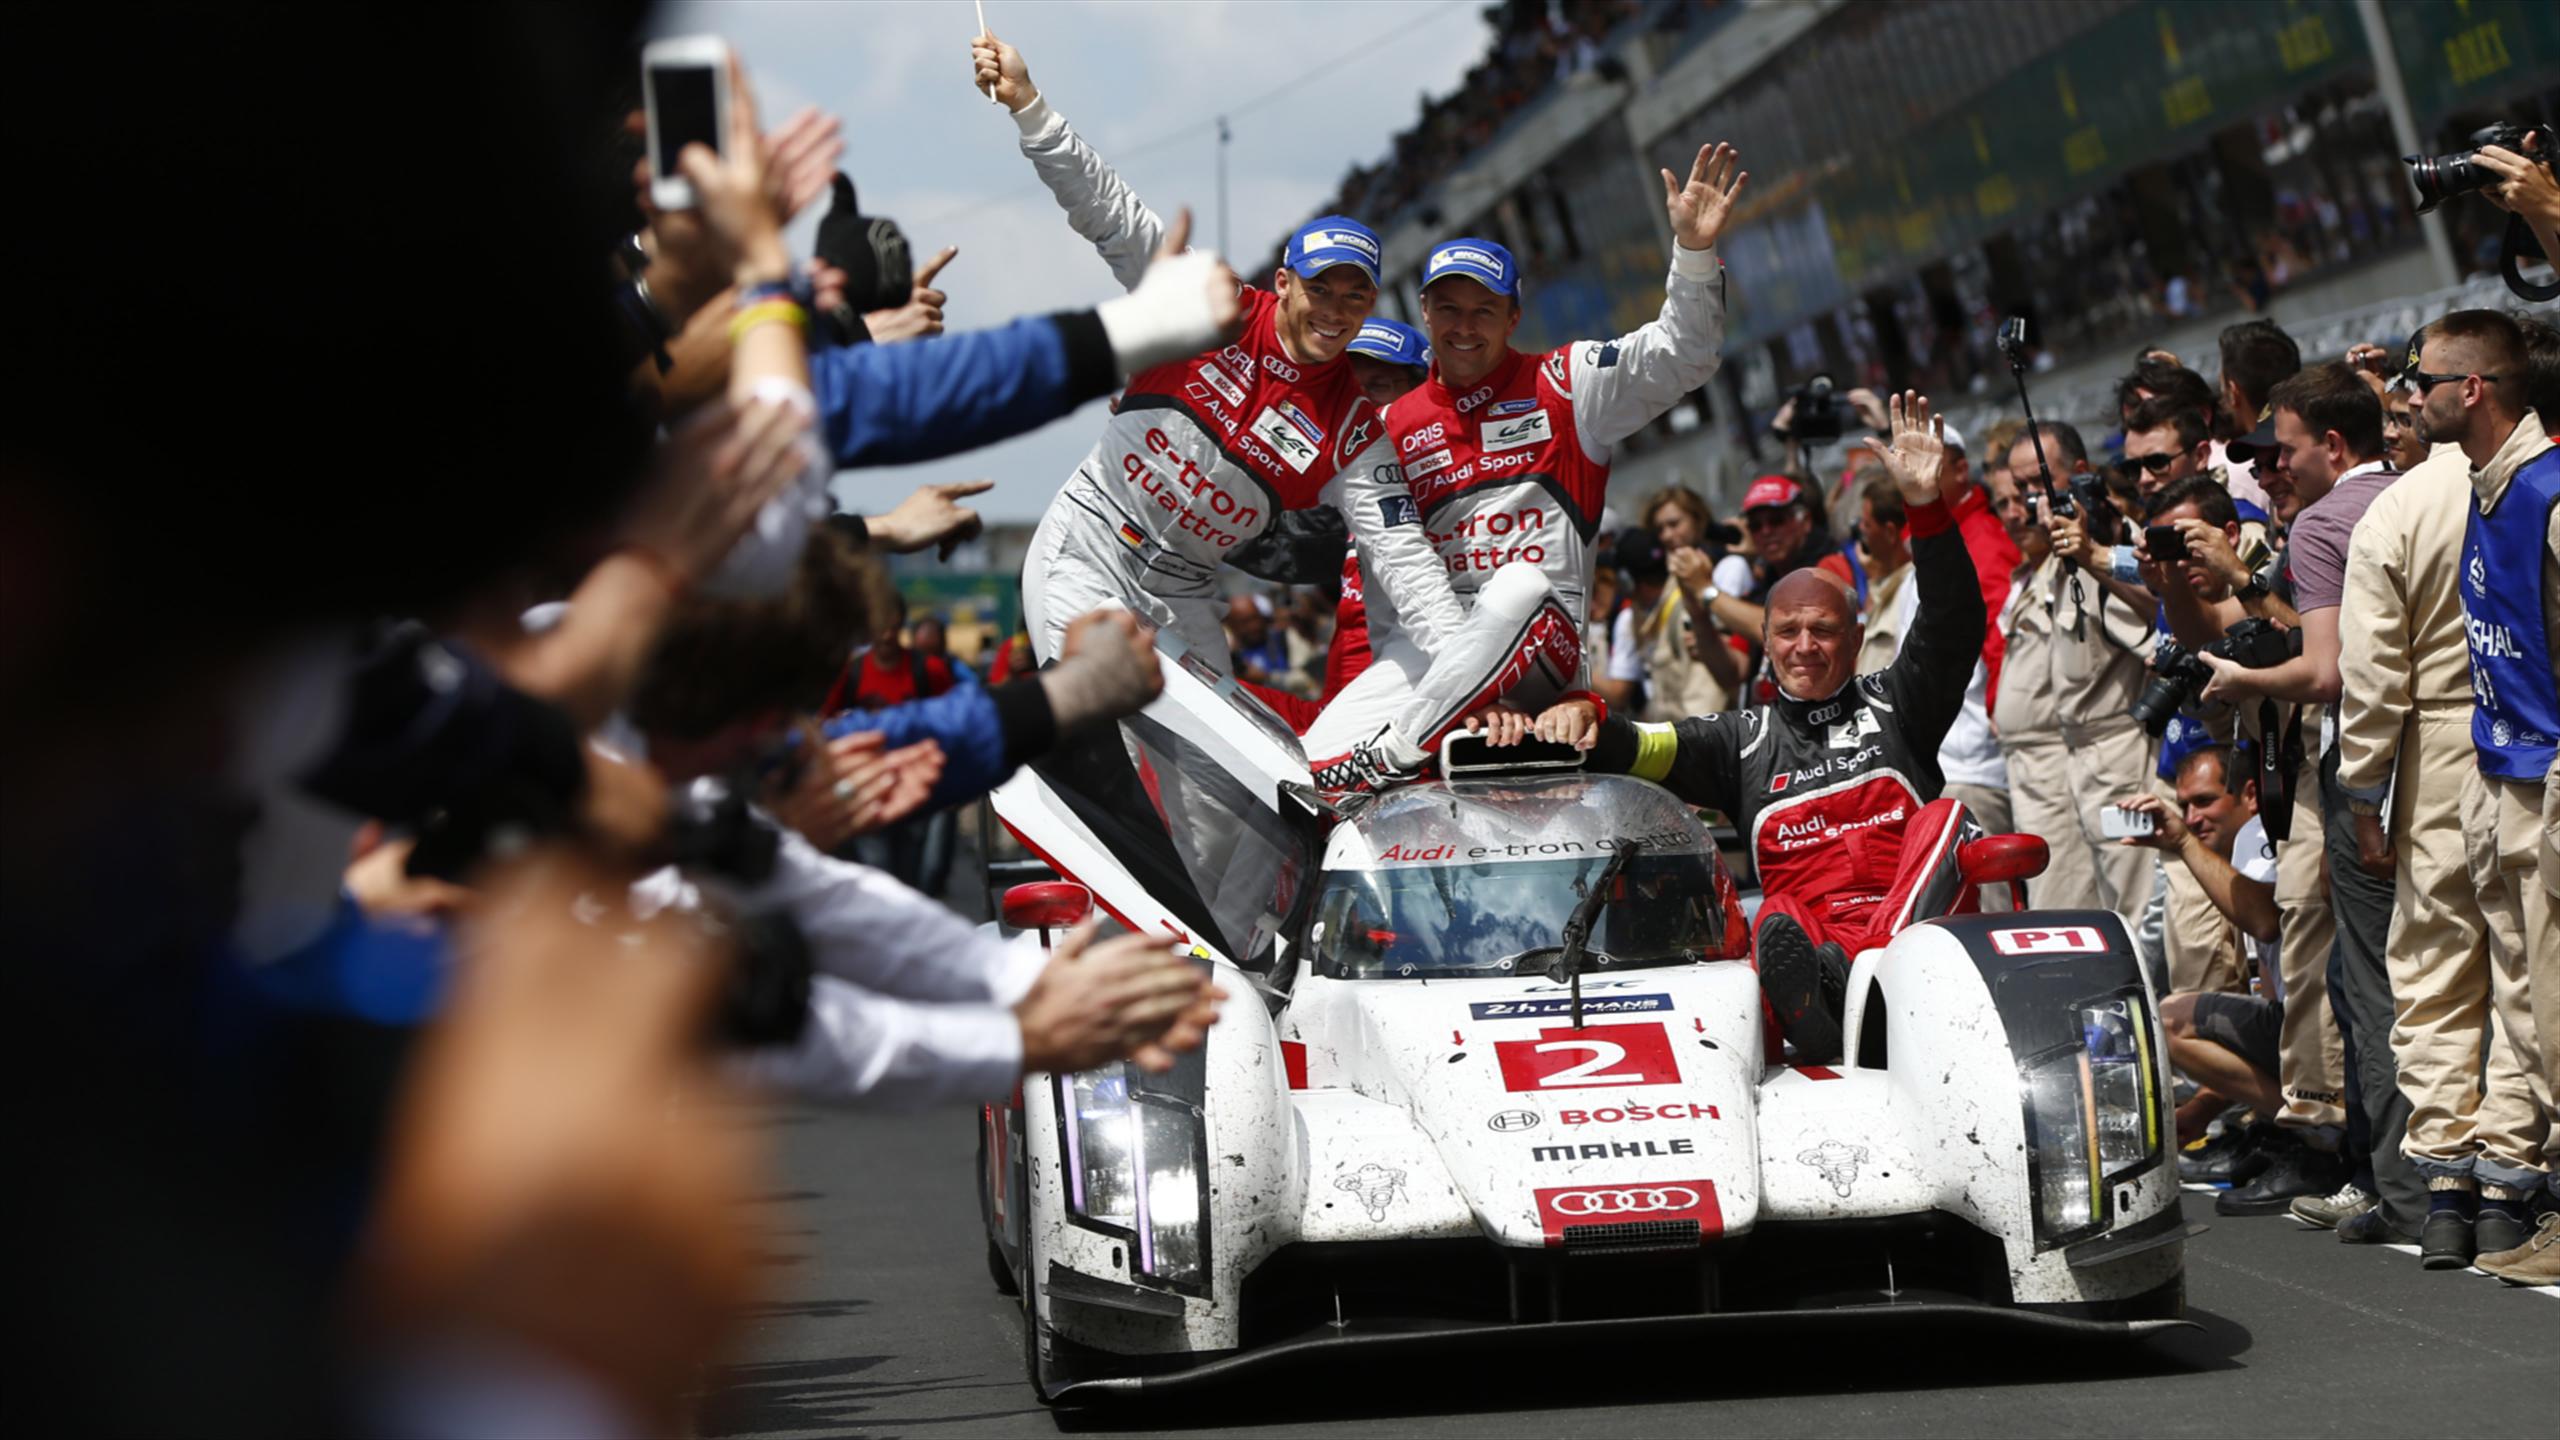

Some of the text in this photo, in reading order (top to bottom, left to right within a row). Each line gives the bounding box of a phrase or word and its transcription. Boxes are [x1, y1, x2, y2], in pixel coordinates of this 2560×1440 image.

[1333, 233, 1377, 254] MICHELIN
[1454, 251, 1501, 272] MICHELIN
[1357, 328, 1401, 343] ICHELIN
[1213, 377, 1242, 404] BOSCH
[1402, 422, 1444, 452] ORIS
[1499, 416, 1545, 437] WEC
[1238, 435, 1284, 477] Sport
[1420, 452, 1450, 470] BOSCH
[1145, 427, 1259, 528] e-tron
[1433, 450, 1536, 489] Audi Sport
[1123, 453, 1237, 548] quattro
[2264, 731, 2275, 771] Canon
[1794, 744, 1883, 785] Audi Sport
[1777, 814, 1827, 840] Audi
[1379, 843, 1458, 862] Audi
[1467, 840, 1585, 858] e-tron
[2011, 931, 2086, 949] P1
[1544, 1003, 1573, 1012] LE
[1581, 999, 1660, 1011] MANS
[1534, 1039, 1646, 1087] 2
[1559, 1103, 1721, 1126] BOSCH
[1532, 1138, 1695, 1162] MAHLE
